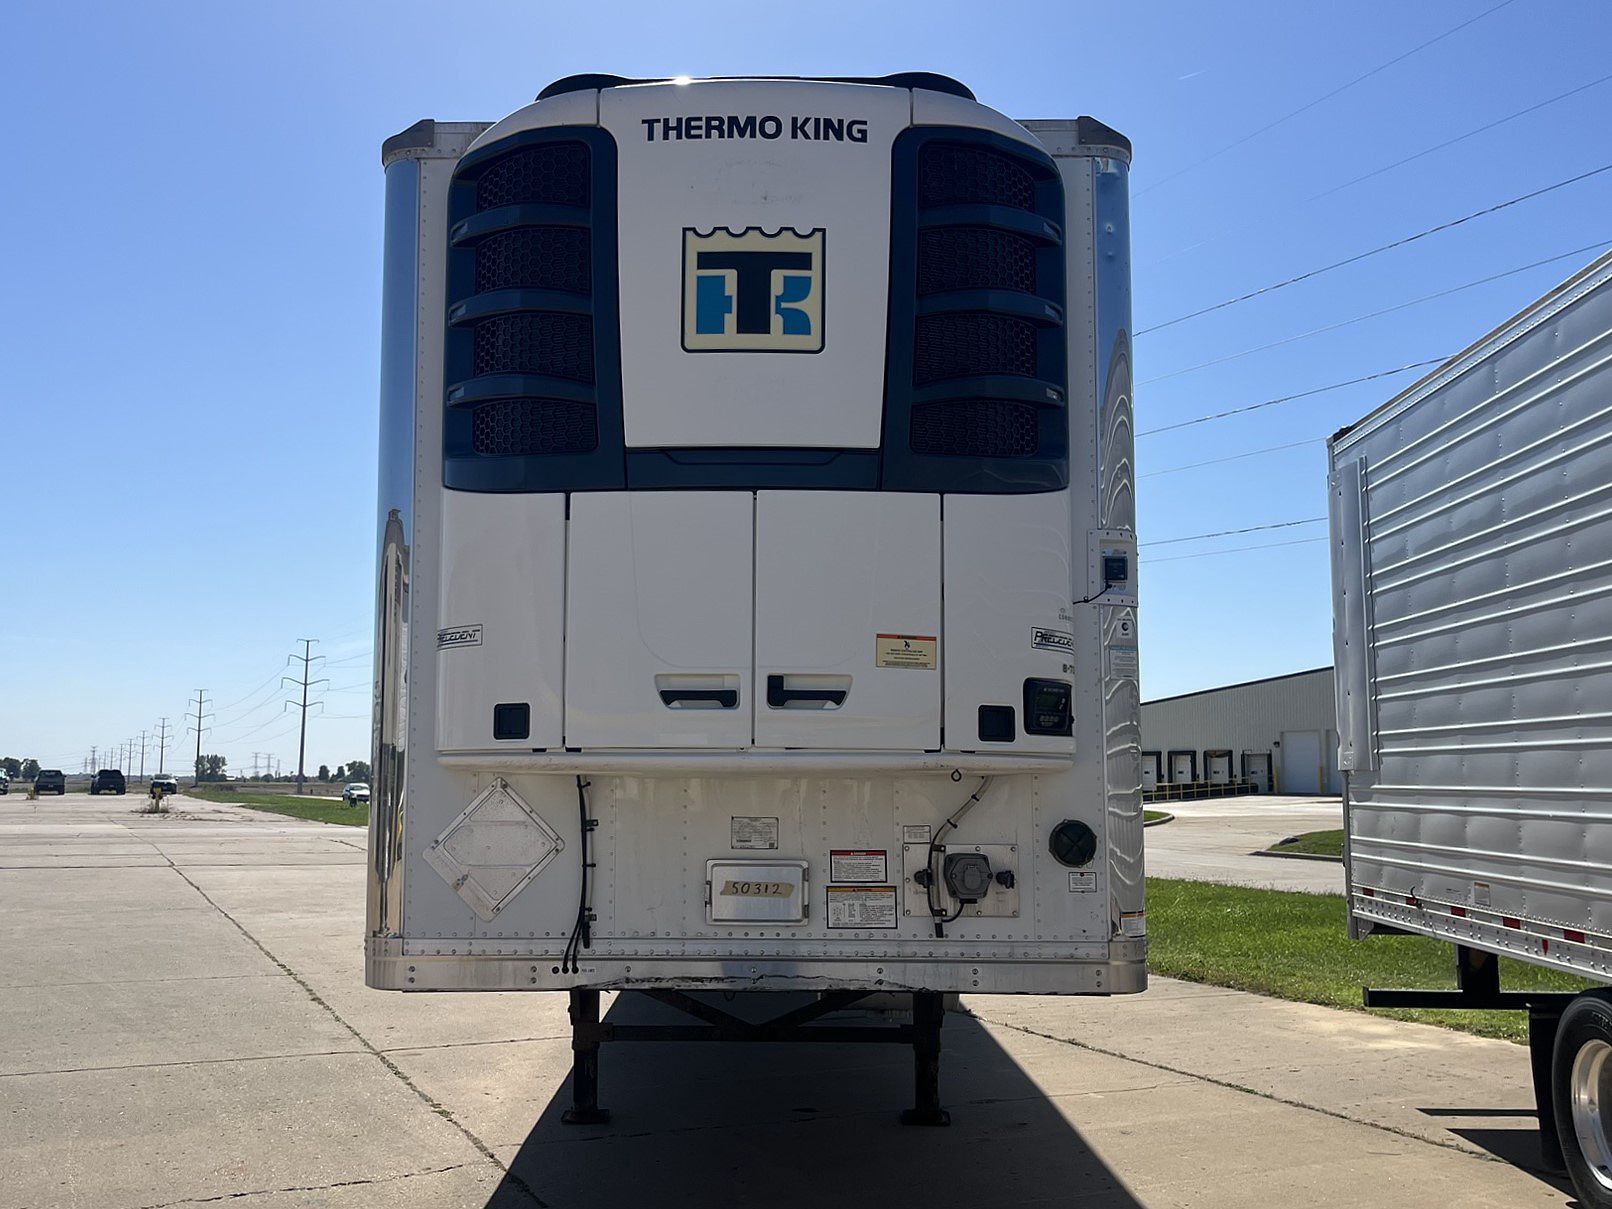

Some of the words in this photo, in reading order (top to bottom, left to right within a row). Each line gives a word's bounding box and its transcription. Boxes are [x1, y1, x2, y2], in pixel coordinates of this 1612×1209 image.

[641, 115, 783, 142] THERMO
[790, 116, 868, 143] KING
[731, 881, 783, 895] 50312
